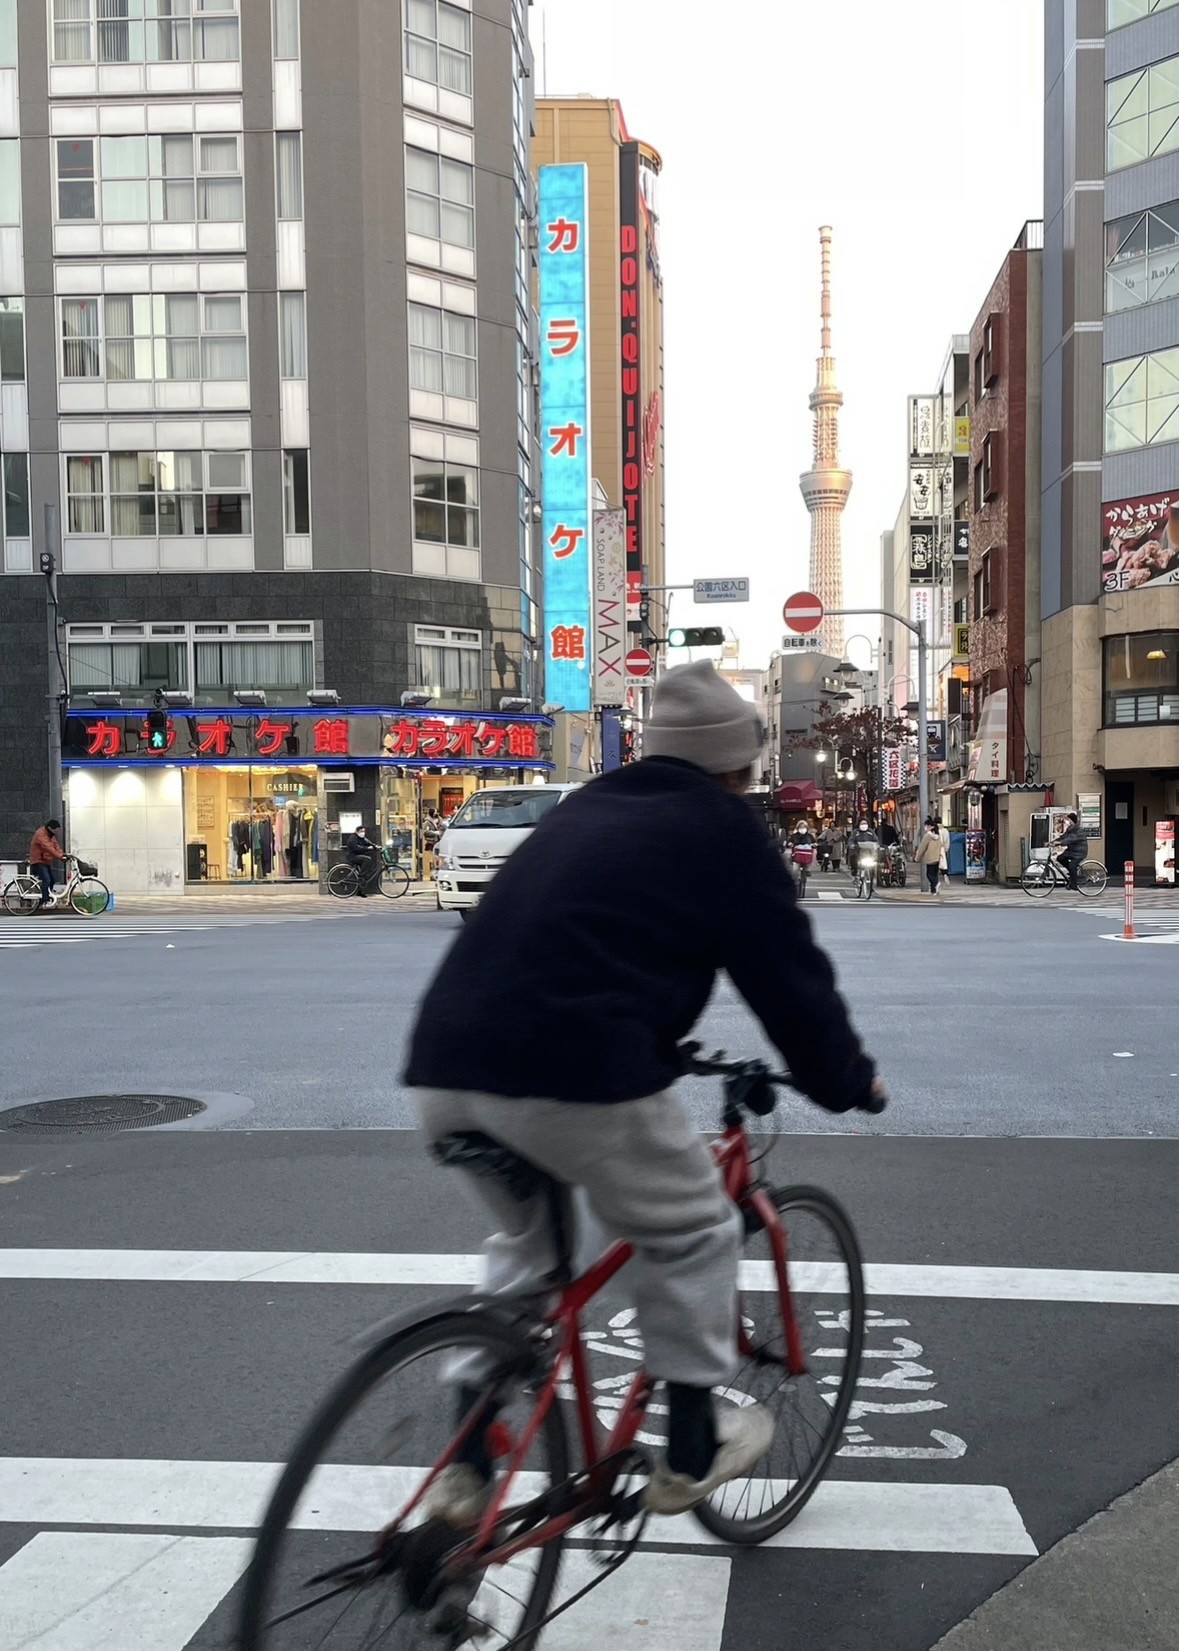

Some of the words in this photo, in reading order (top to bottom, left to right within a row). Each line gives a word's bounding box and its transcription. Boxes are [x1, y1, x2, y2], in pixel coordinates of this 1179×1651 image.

[546, 217, 581, 663] カラオケ館
[1105, 497, 1170, 526] からあげ
[597, 538, 605, 566] SOAP
[597, 567, 605, 592] LAND
[696, 580, 748, 593] 公園六区入口
[1105, 571, 1130, 591] 3F
[597, 599, 622, 677] MAX
[783, 637, 822, 649] 自転車を除く
[391, 719, 537, 758] カラオケ館
[888, 750, 901, 790] 六区花道
[991, 741, 1000, 778] タイ料理
[266, 783, 304, 792] CASHIER
